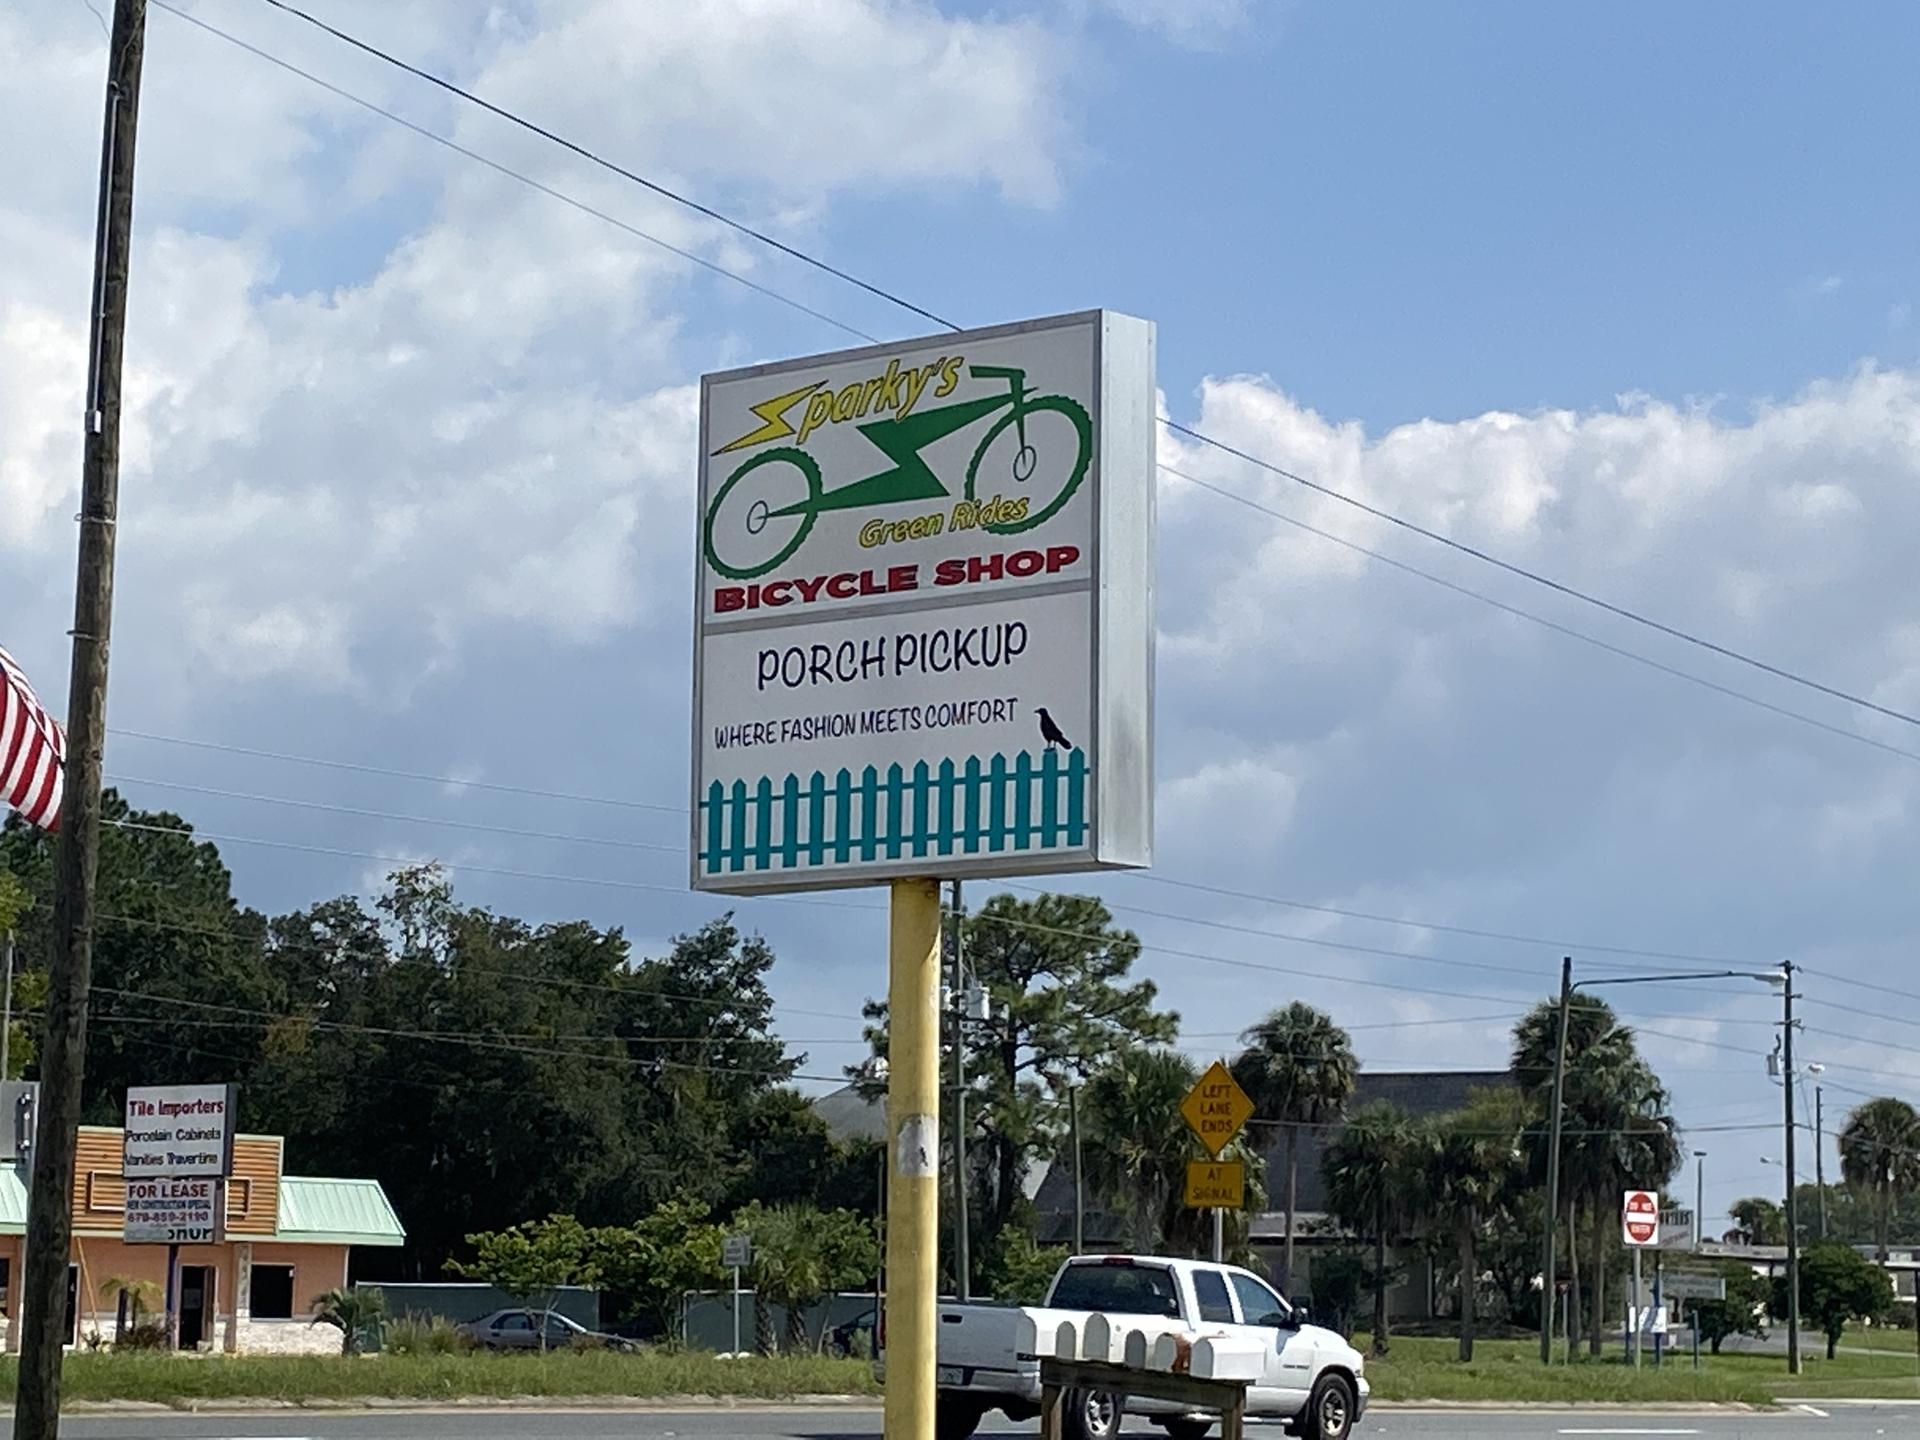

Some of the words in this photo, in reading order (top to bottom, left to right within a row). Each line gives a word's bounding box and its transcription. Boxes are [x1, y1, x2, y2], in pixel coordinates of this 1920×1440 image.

[711, 356, 964, 456] Sparky's
[859, 510, 943, 548] Green
[949, 495, 1030, 532] Rides
[714, 564, 919, 613] BICYCLE
[933, 545, 1080, 586] SHOP
[757, 636, 886, 691] PORCH
[895, 621, 1027, 676] PICKUP
[715, 721, 777, 750] WHERE
[781, 713, 857, 743] FASHION
[860, 706, 922, 734] MEETS
[924, 698, 1018, 730] COMFORT
[1202, 1085, 1232, 1098] LEFT
[129, 1100, 154, 1116] Tile
[159, 1098, 224, 1118] Importers
[1200, 1102, 1232, 1115] LANE
[1201, 1119, 1233, 1133] ENDS
[175, 1127, 221, 1141] Cabinets
[1207, 1168, 1222, 1180] AT
[129, 1185, 157, 1198] FOR
[161, 1184, 209, 1198] LEASE
[1193, 1187, 1233, 1200] SIGNAL
